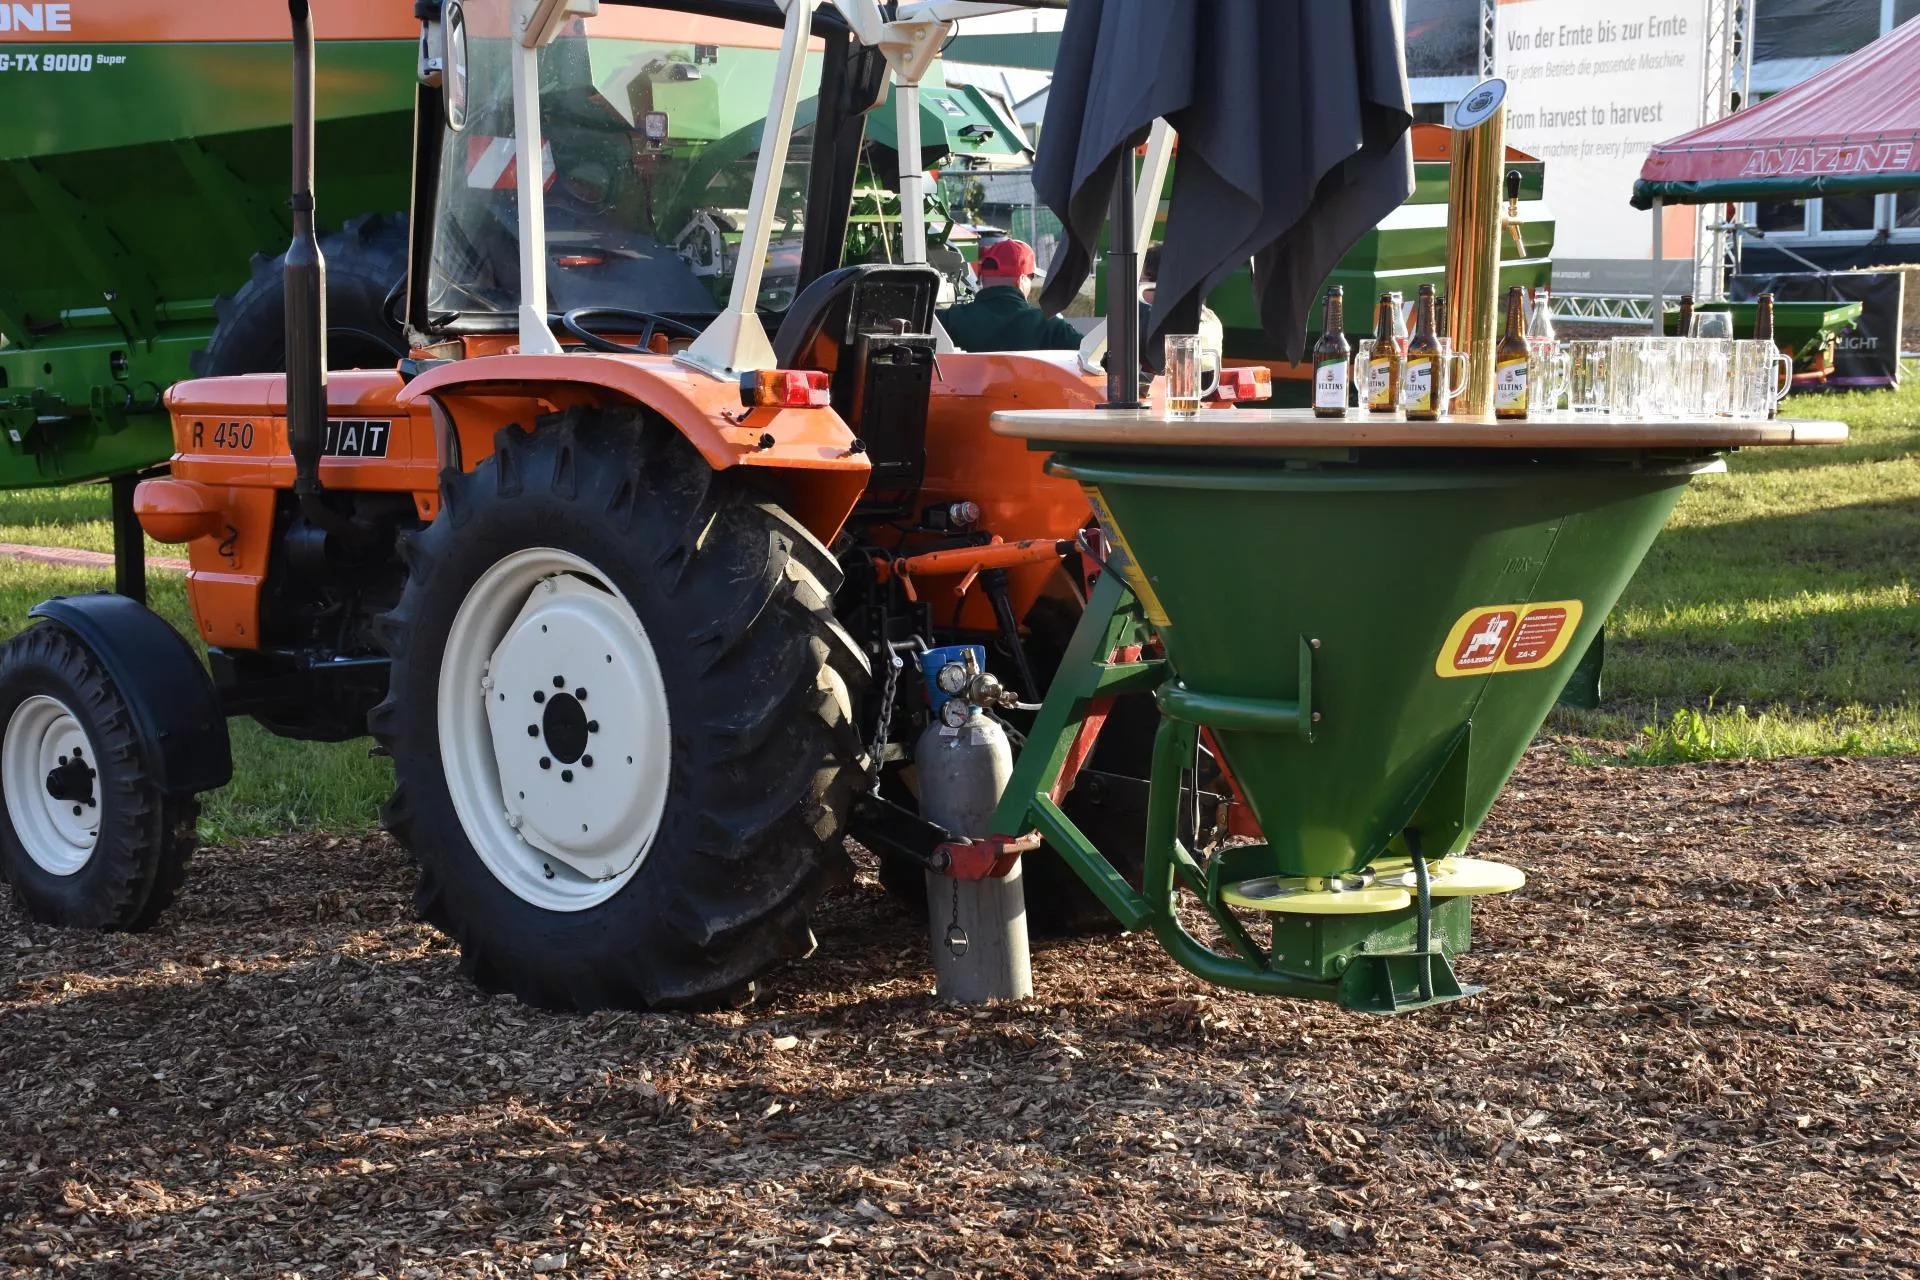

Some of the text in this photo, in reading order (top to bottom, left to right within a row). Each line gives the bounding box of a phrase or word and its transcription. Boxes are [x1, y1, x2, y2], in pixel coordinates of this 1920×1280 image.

[1508, 15, 1687, 51] Von der Ernte bis zur Ernte
[43, 54, 92, 71] 9000
[96, 54, 127, 66] Super
[1506, 51, 1685, 84] Für jeden Betrieb die passende Maschine
[1506, 101, 1663, 129] From harvest to harvest
[1543, 140, 1580, 157] machine
[1580, 138, 1595, 159] for
[1596, 141, 1621, 159] every
[1739, 142, 1914, 177] AMAZONE
[192, 421, 254, 450] R 450
[1457, 655, 1495, 665] AMAZONE
[1516, 650, 1537, 659] ZA-S
